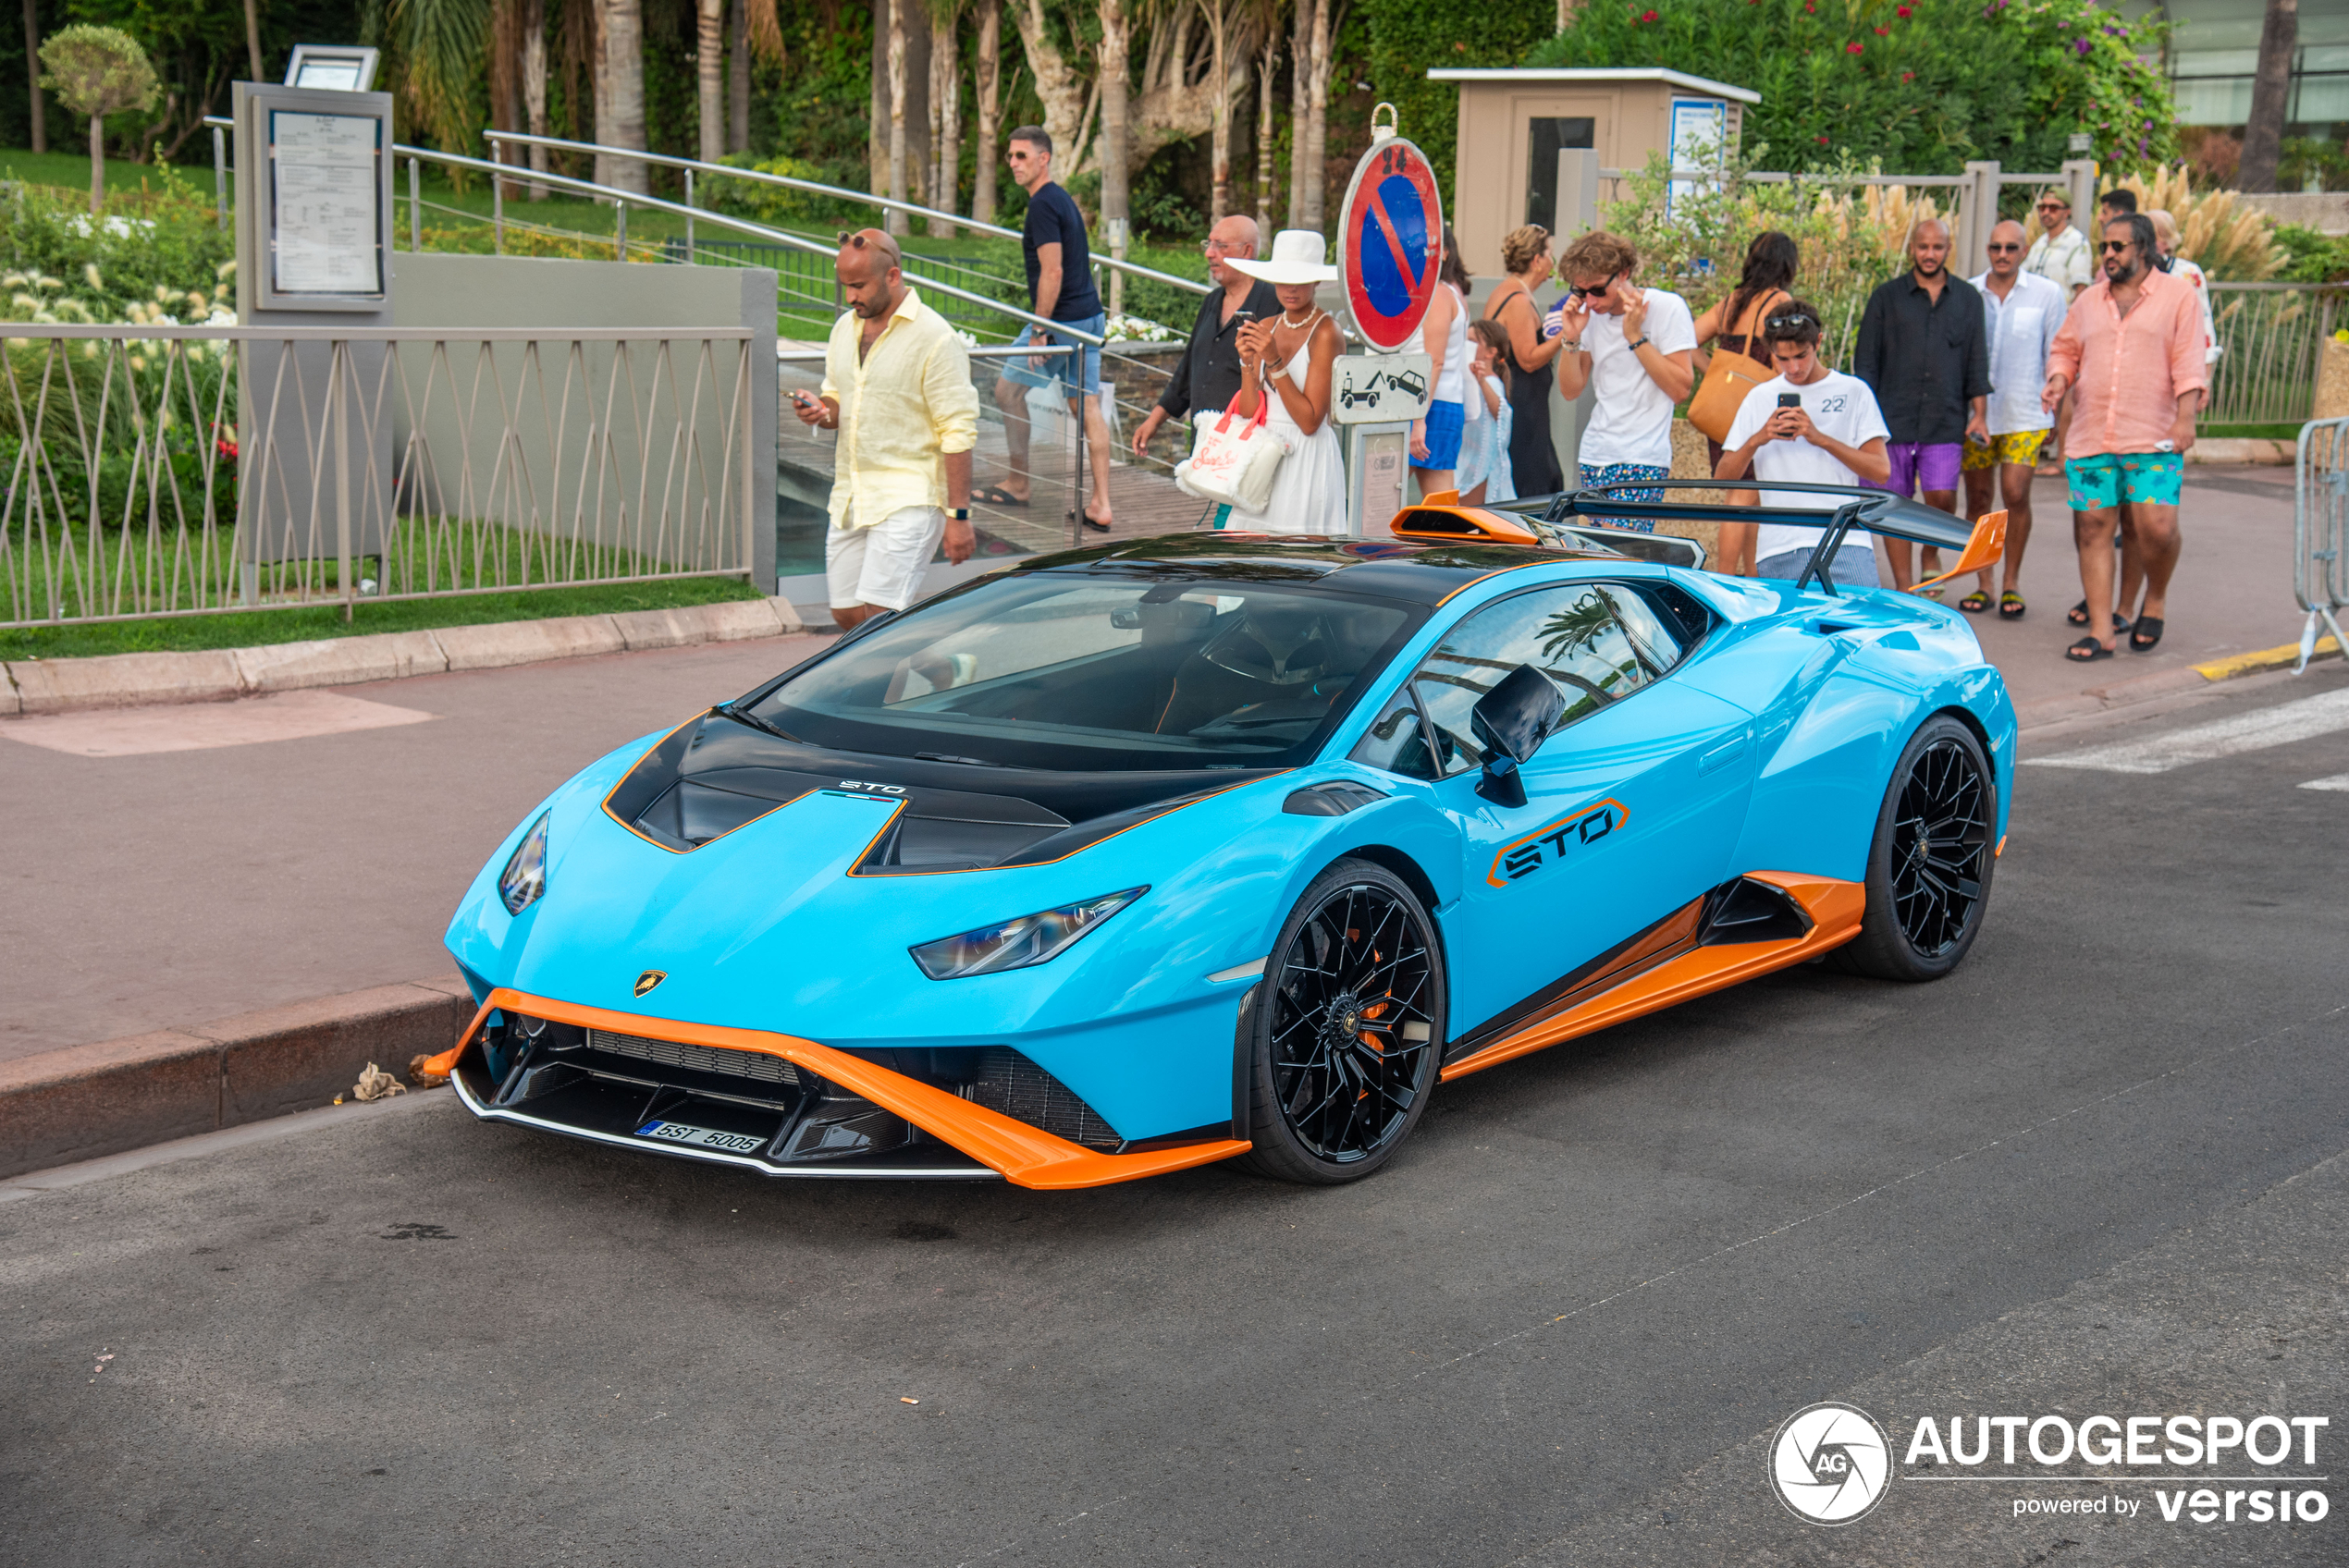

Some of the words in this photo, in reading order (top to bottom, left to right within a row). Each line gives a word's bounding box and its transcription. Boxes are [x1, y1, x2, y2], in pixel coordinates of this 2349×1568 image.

[1821, 398, 1845, 413] 22
[839, 780, 906, 794] STO
[1505, 808, 1613, 879] STO
[657, 1124, 700, 1140] 5ST
[703, 1132, 760, 1150] 5005
